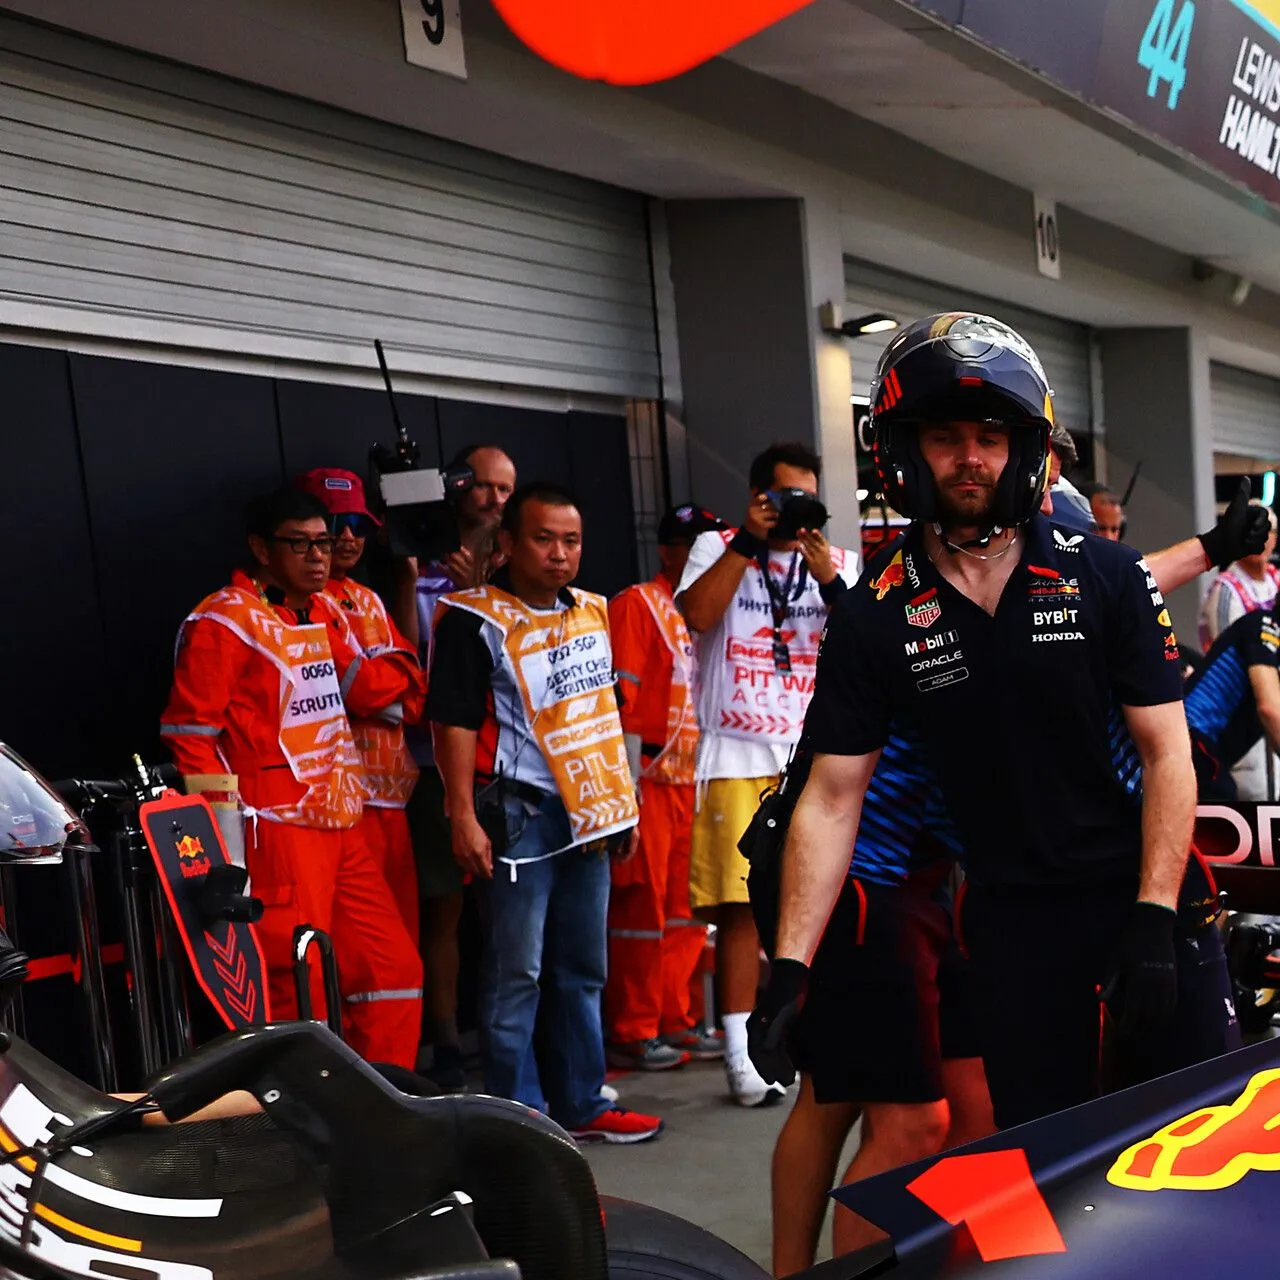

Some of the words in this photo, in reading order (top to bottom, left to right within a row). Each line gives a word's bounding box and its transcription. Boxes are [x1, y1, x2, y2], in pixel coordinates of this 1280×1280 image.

[1138, 0, 1196, 110] 44
[904, 553, 921, 589] zoom
[909, 606, 941, 626] HEUER
[1033, 607, 1079, 626] BYBIT
[904, 633, 944, 656] Mobil
[1032, 631, 1086, 642] HONDA
[911, 650, 963, 673] ORACLE
[735, 666, 775, 688] PIT
[931, 674, 954, 686] ADAM
[904, 1148, 1068, 1263] 1
